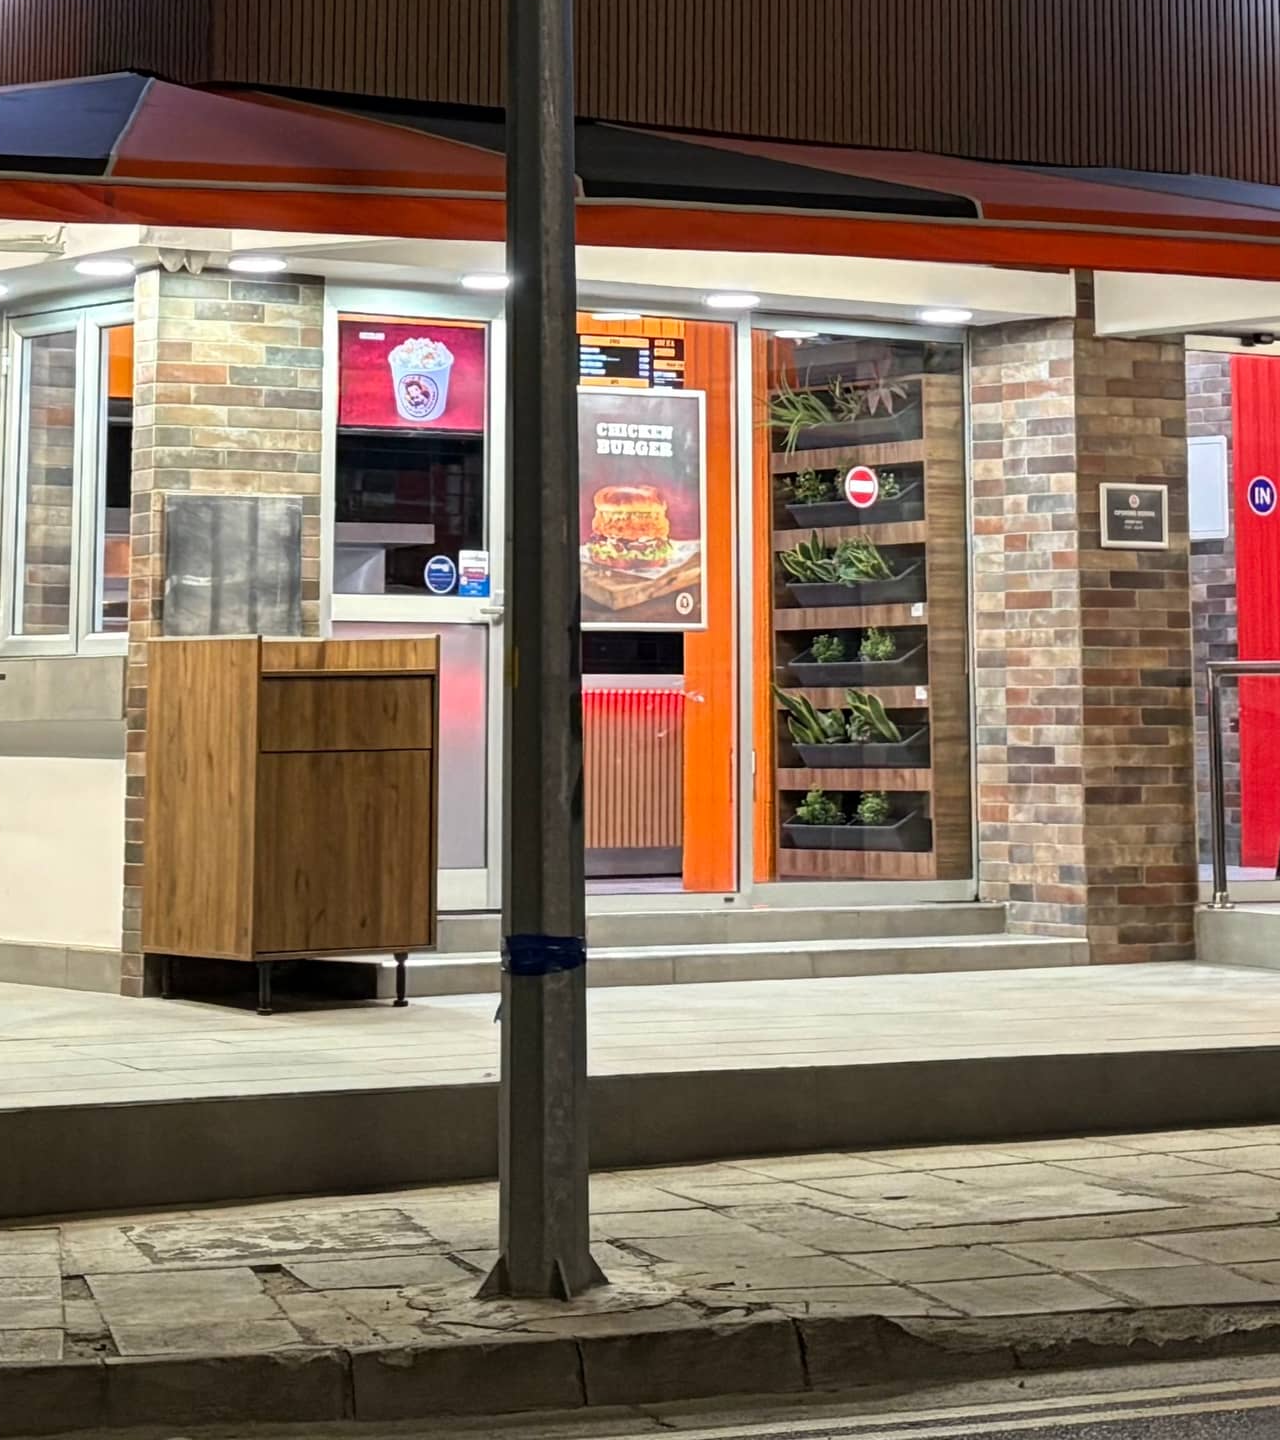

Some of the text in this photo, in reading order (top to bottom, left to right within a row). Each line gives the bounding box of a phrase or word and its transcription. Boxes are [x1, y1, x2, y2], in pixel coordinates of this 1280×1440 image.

[596, 422, 674, 440] CHICKEN
[596, 438, 673, 457] BURGER
[1254, 486, 1271, 505] IN
